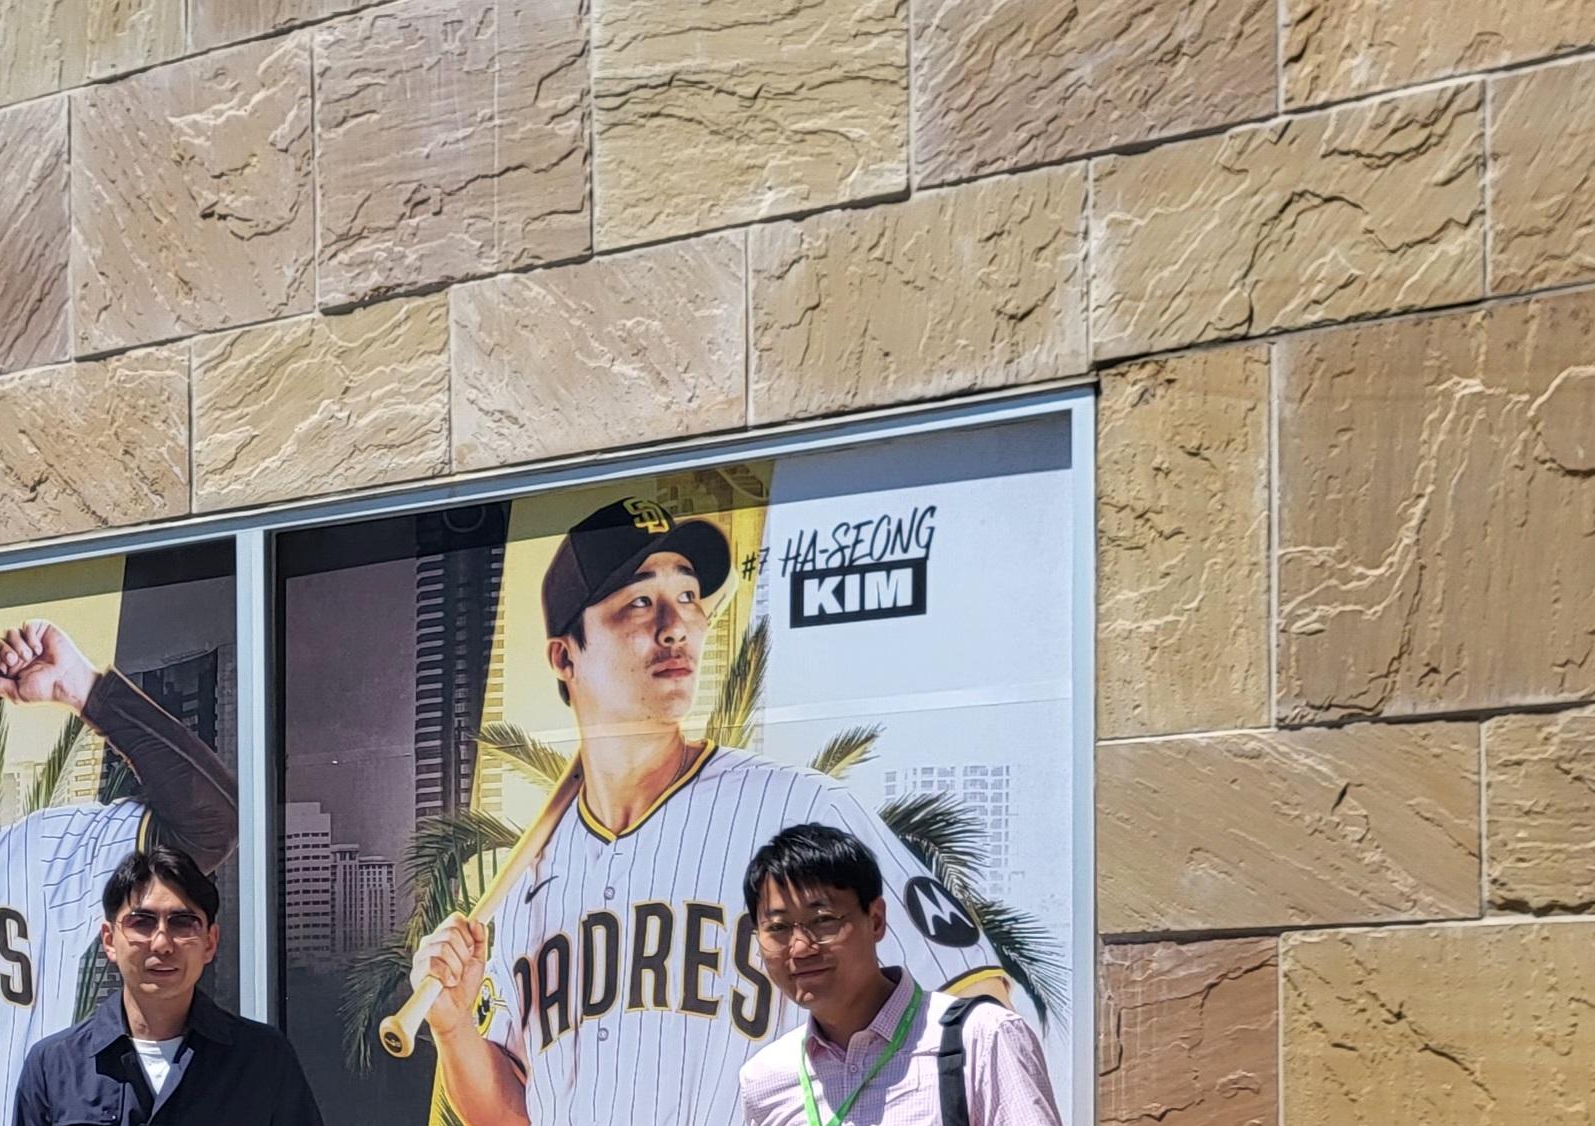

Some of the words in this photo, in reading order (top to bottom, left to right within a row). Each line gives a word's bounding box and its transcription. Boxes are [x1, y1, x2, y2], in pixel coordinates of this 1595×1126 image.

[741, 546, 771, 581] #7
[778, 505, 938, 578] HA-SEONG
[803, 567, 913, 617] KIM
